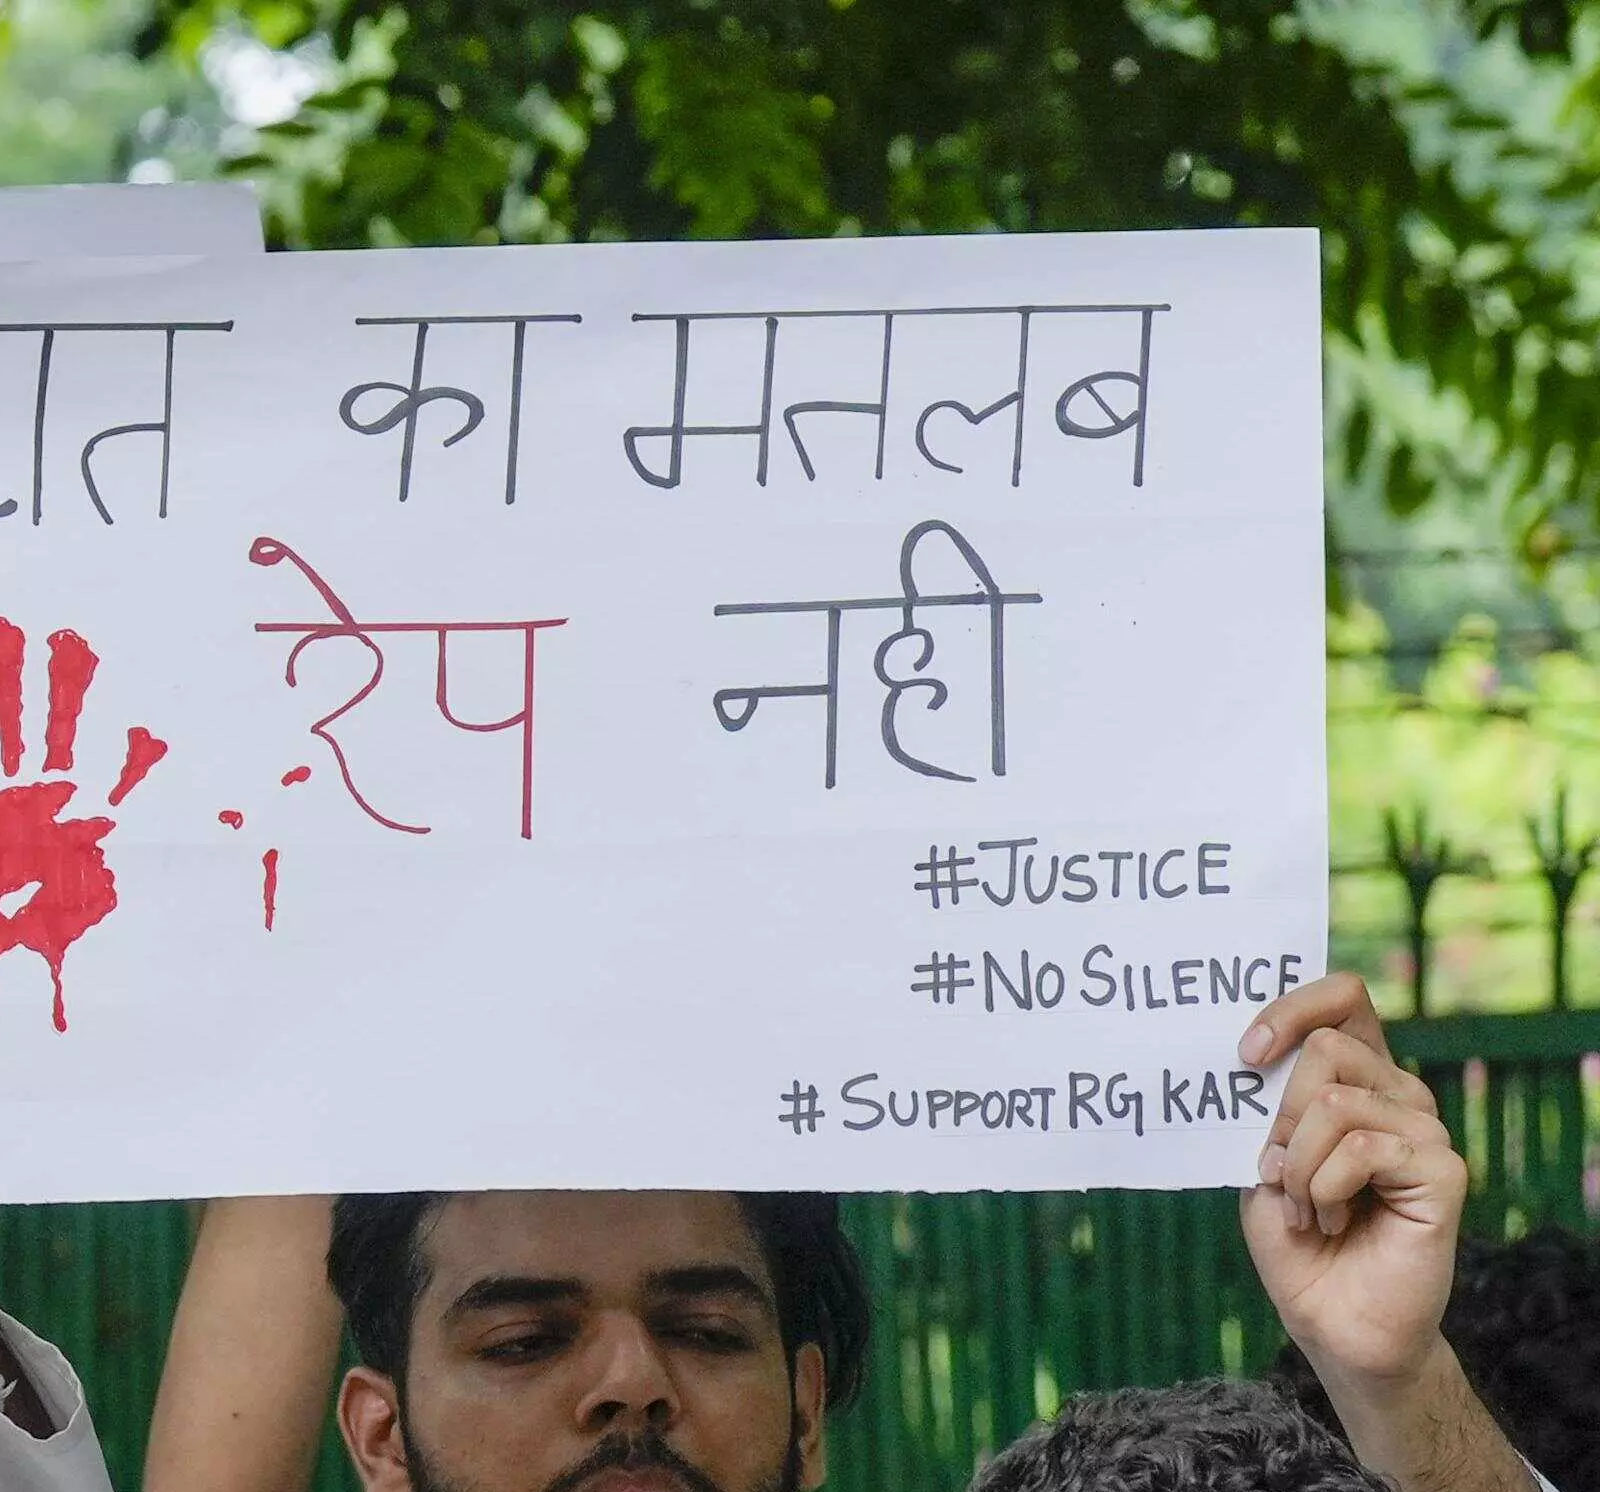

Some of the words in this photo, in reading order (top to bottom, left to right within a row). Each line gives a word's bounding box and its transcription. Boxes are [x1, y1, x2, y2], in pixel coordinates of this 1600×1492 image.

[339, 314, 582, 505] का
[623, 304, 1171, 489] मतलब
[249, 537, 569, 838] रेप
[1162, 1068, 1268, 1121] KAR
